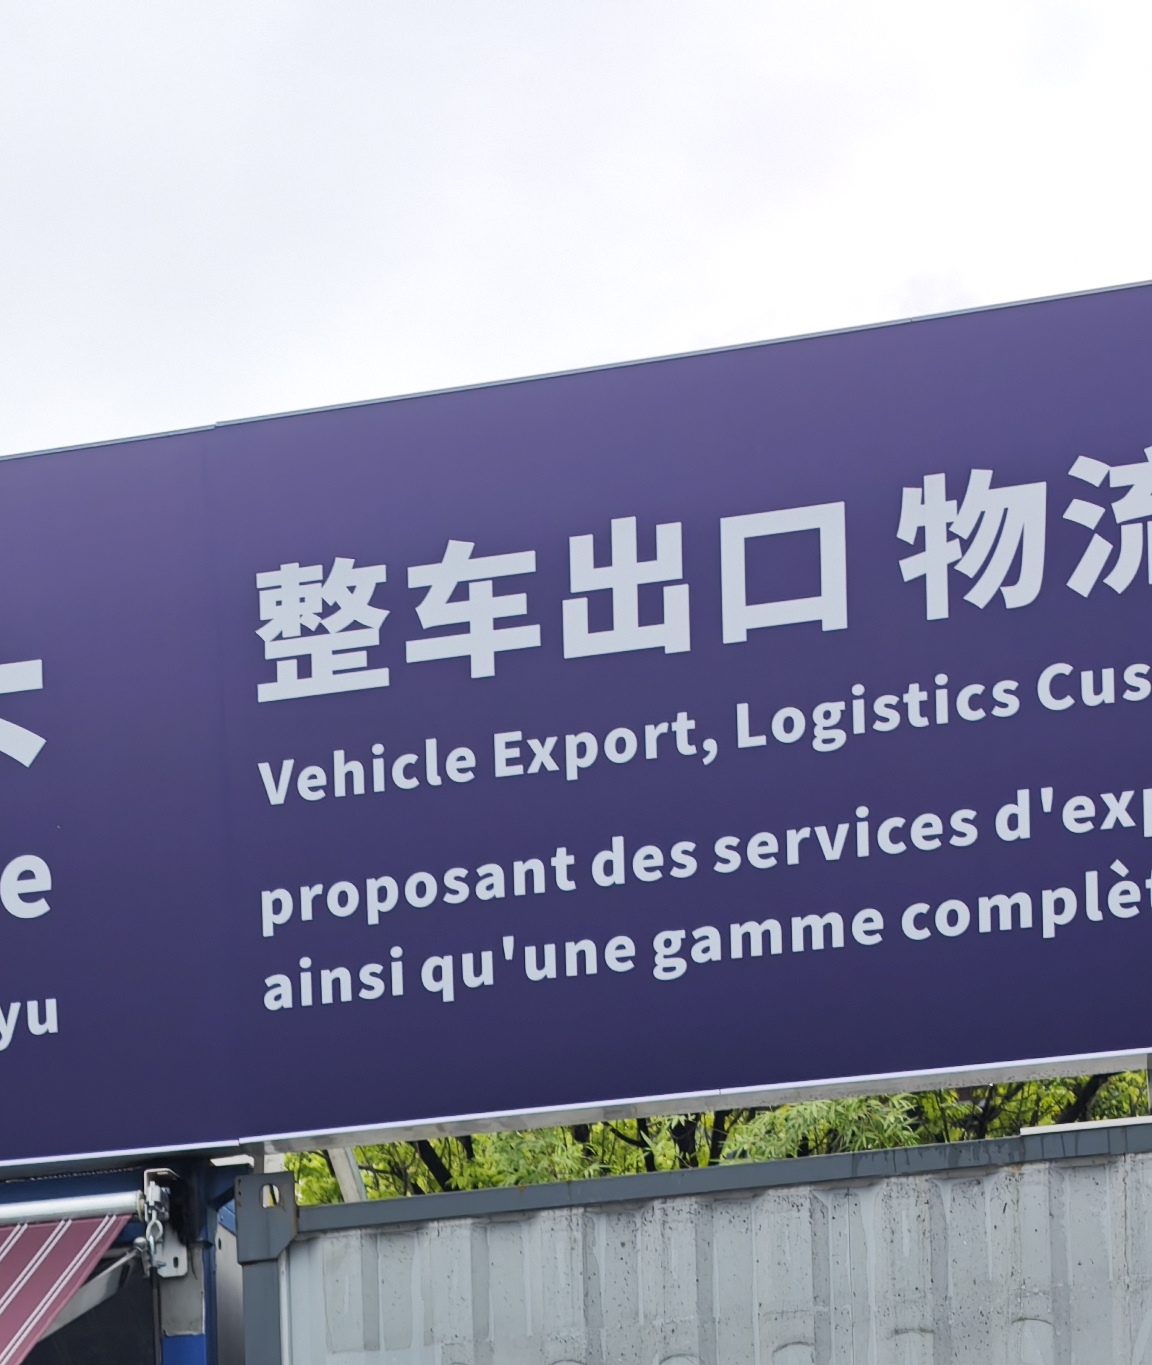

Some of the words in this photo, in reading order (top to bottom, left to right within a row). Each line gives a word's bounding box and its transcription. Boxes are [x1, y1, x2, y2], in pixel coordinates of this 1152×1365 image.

[255, 501, 848, 703] 整车出口
[257, 737, 476, 806] Vehicle
[493, 711, 718, 781] Export,
[735, 672, 1020, 752] Logistics
[1037, 662, 1152, 711] Cus
[261, 846, 577, 938] proposant
[591, 835, 698, 887] des
[713, 805, 979, 873] services
[994, 786, 1152, 842] d'ex
[263, 946, 404, 1011] ainsi
[421, 919, 636, 1003] qu'une
[652, 908, 884, 981] gamme
[900, 859, 1152, 939] complè
